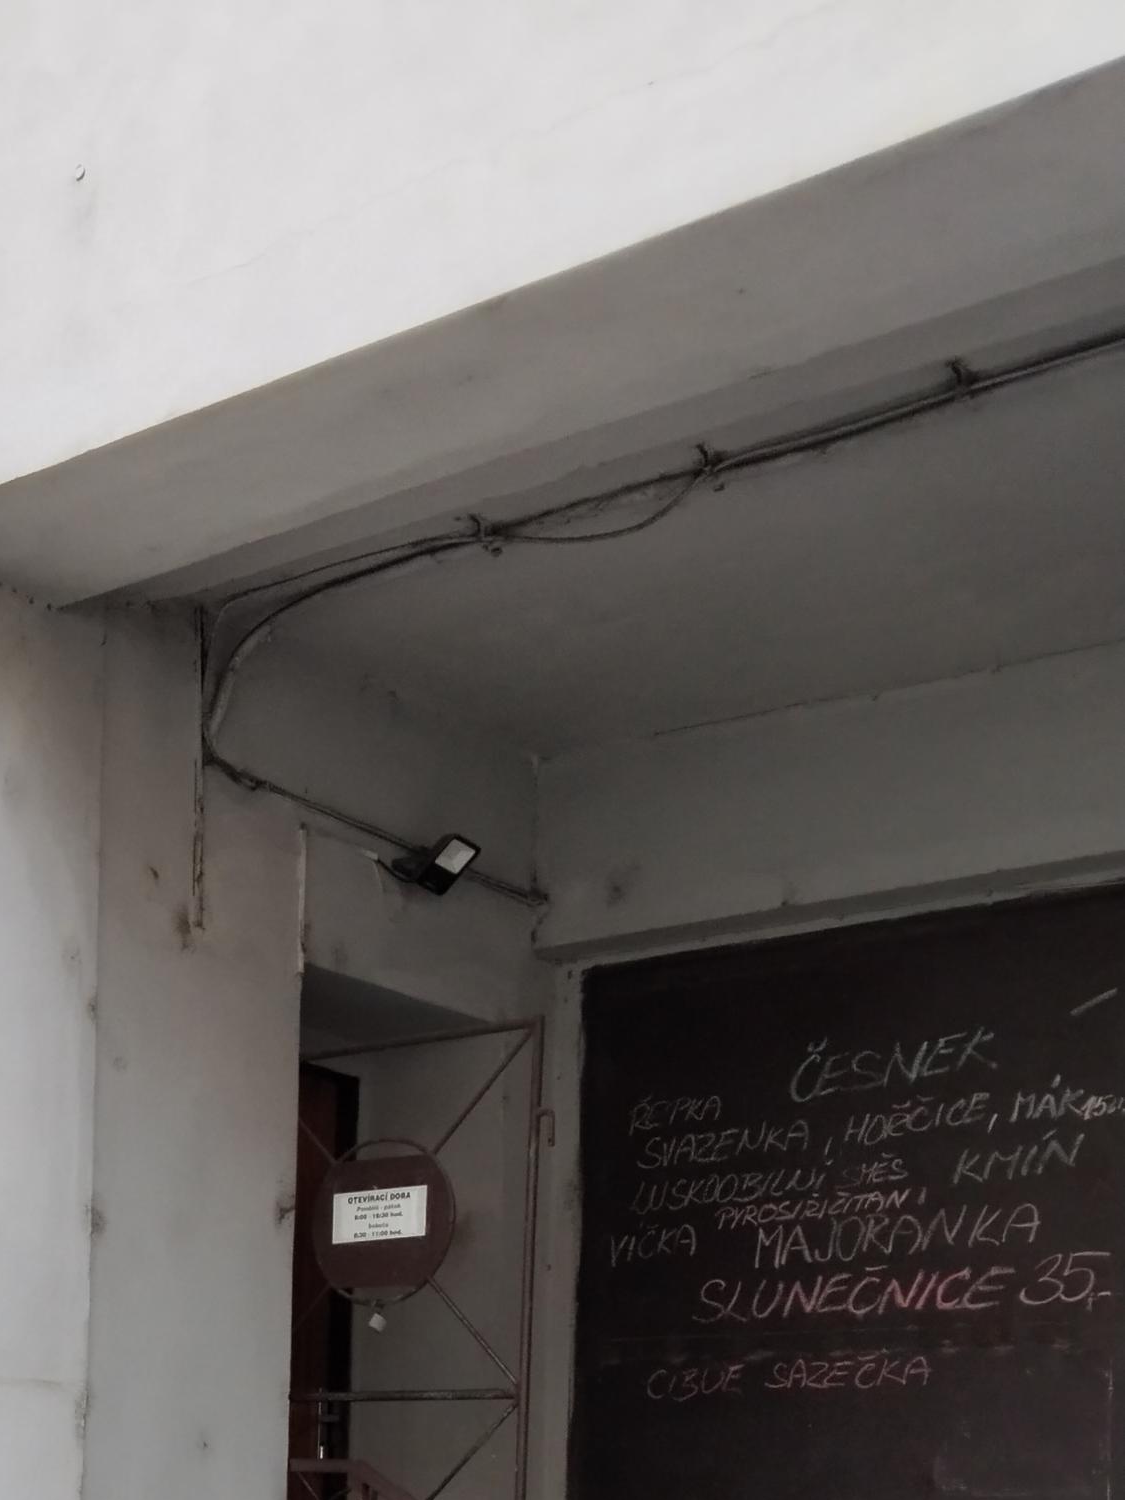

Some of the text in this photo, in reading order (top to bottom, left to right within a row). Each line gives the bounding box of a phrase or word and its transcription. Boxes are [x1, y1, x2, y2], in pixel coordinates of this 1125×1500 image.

[789, 1027, 998, 1102] ČESNEK
[1009, 1074, 1084, 1123] MÁK
[953, 1129, 1085, 1184] KMÍN
[691, 1266, 1015, 1324] SLUNEČNICE
[764, 1353, 933, 1389] SAZEČKA
